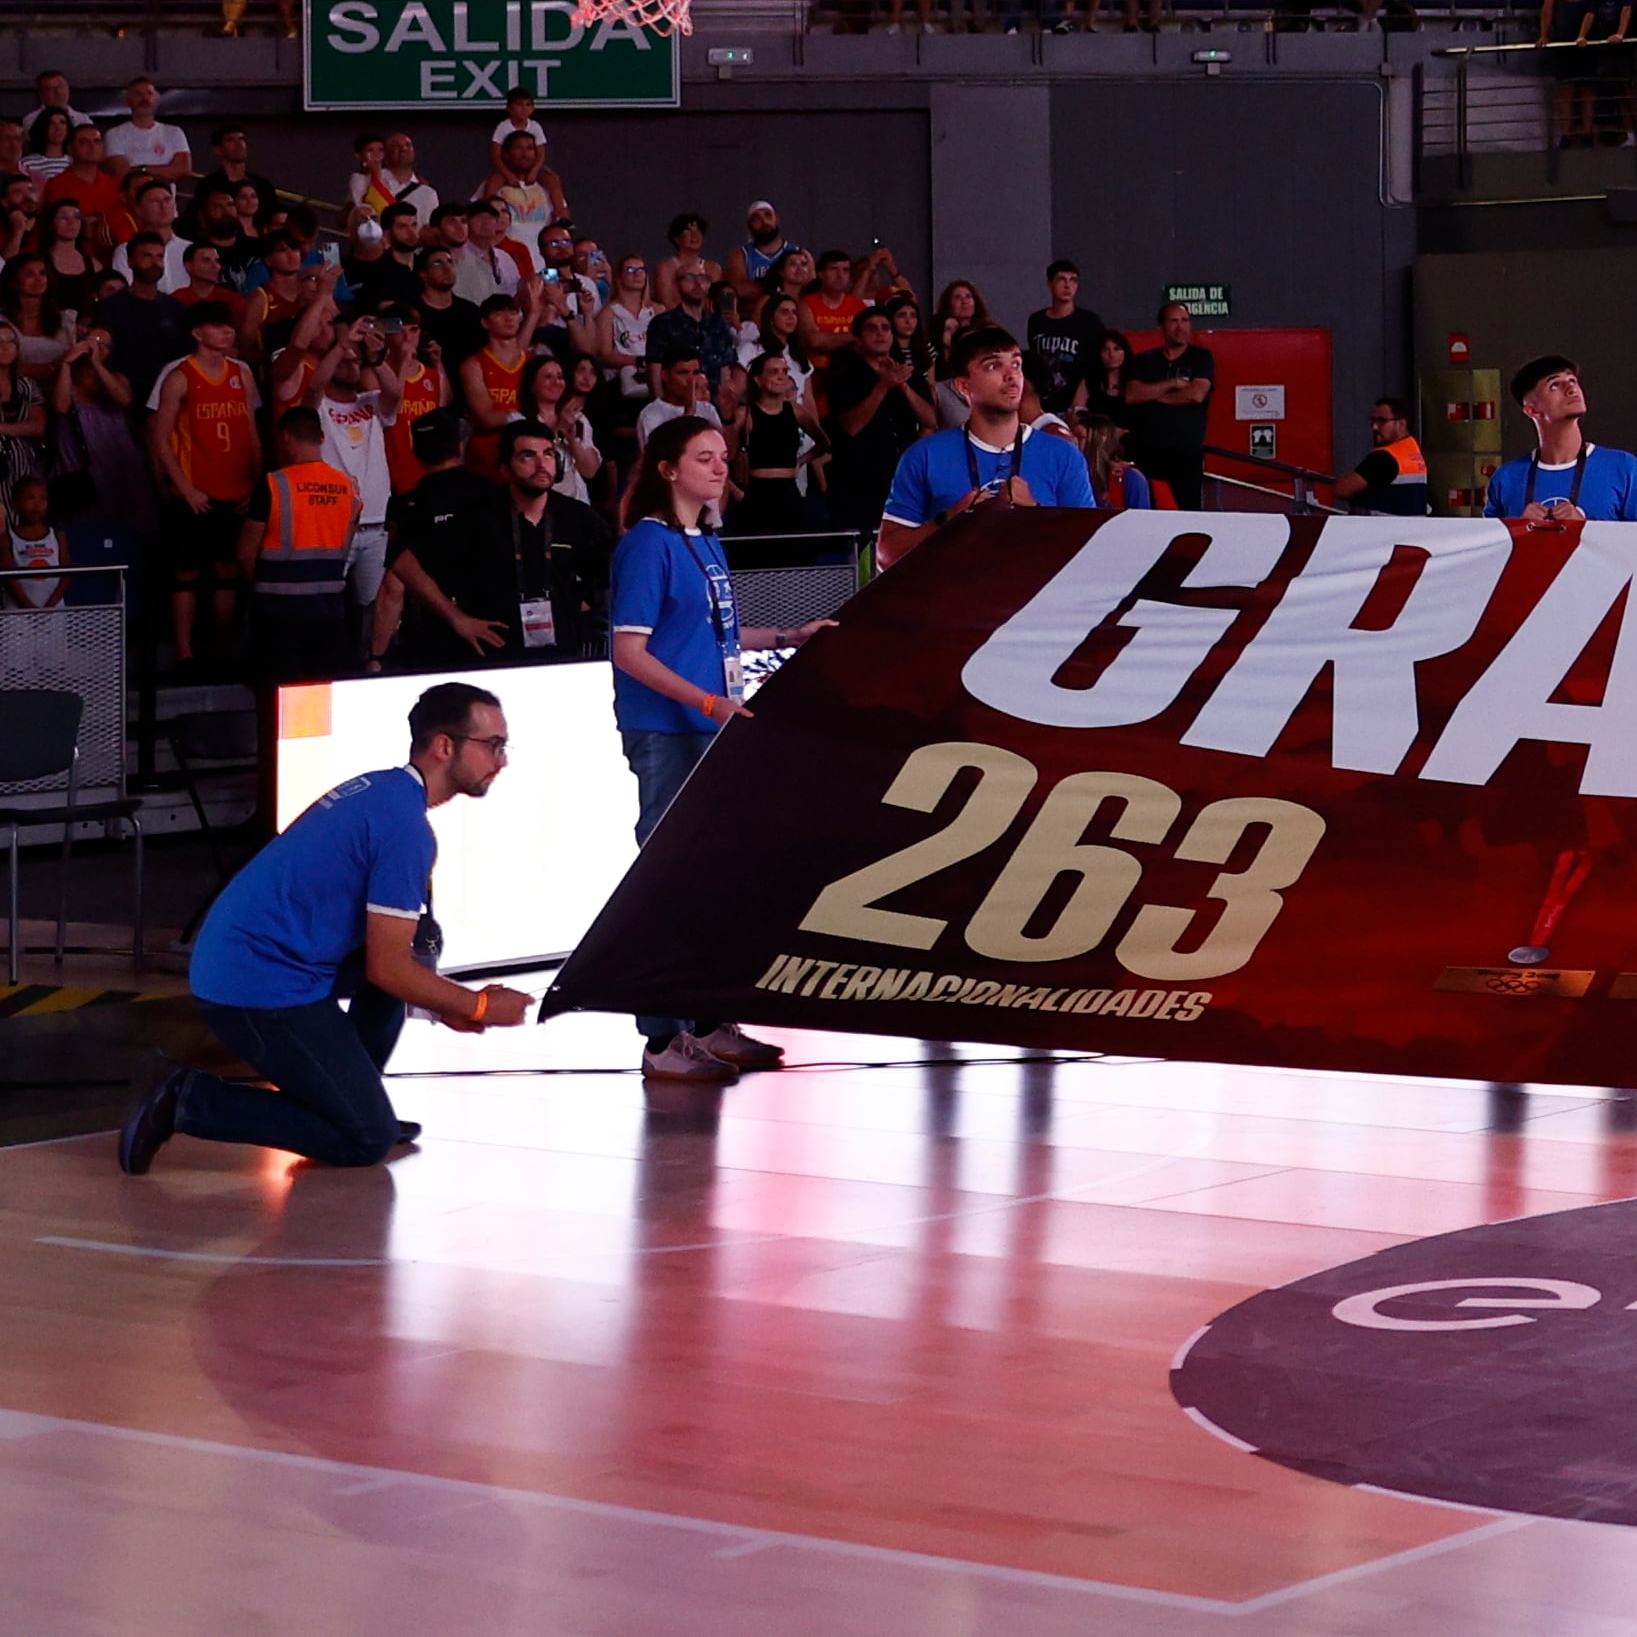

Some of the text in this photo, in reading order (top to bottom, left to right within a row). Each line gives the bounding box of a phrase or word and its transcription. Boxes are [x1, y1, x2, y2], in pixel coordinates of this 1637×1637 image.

[327, 0, 652, 53] SALIDA
[420, 59, 562, 99] EXIT
[1169, 286, 1223, 301] SALIDA DE
[216, 421, 231, 453] 9
[800, 742, 1326, 980] 263
[755, 954, 1213, 1022] INTERNACIONALIDADES
